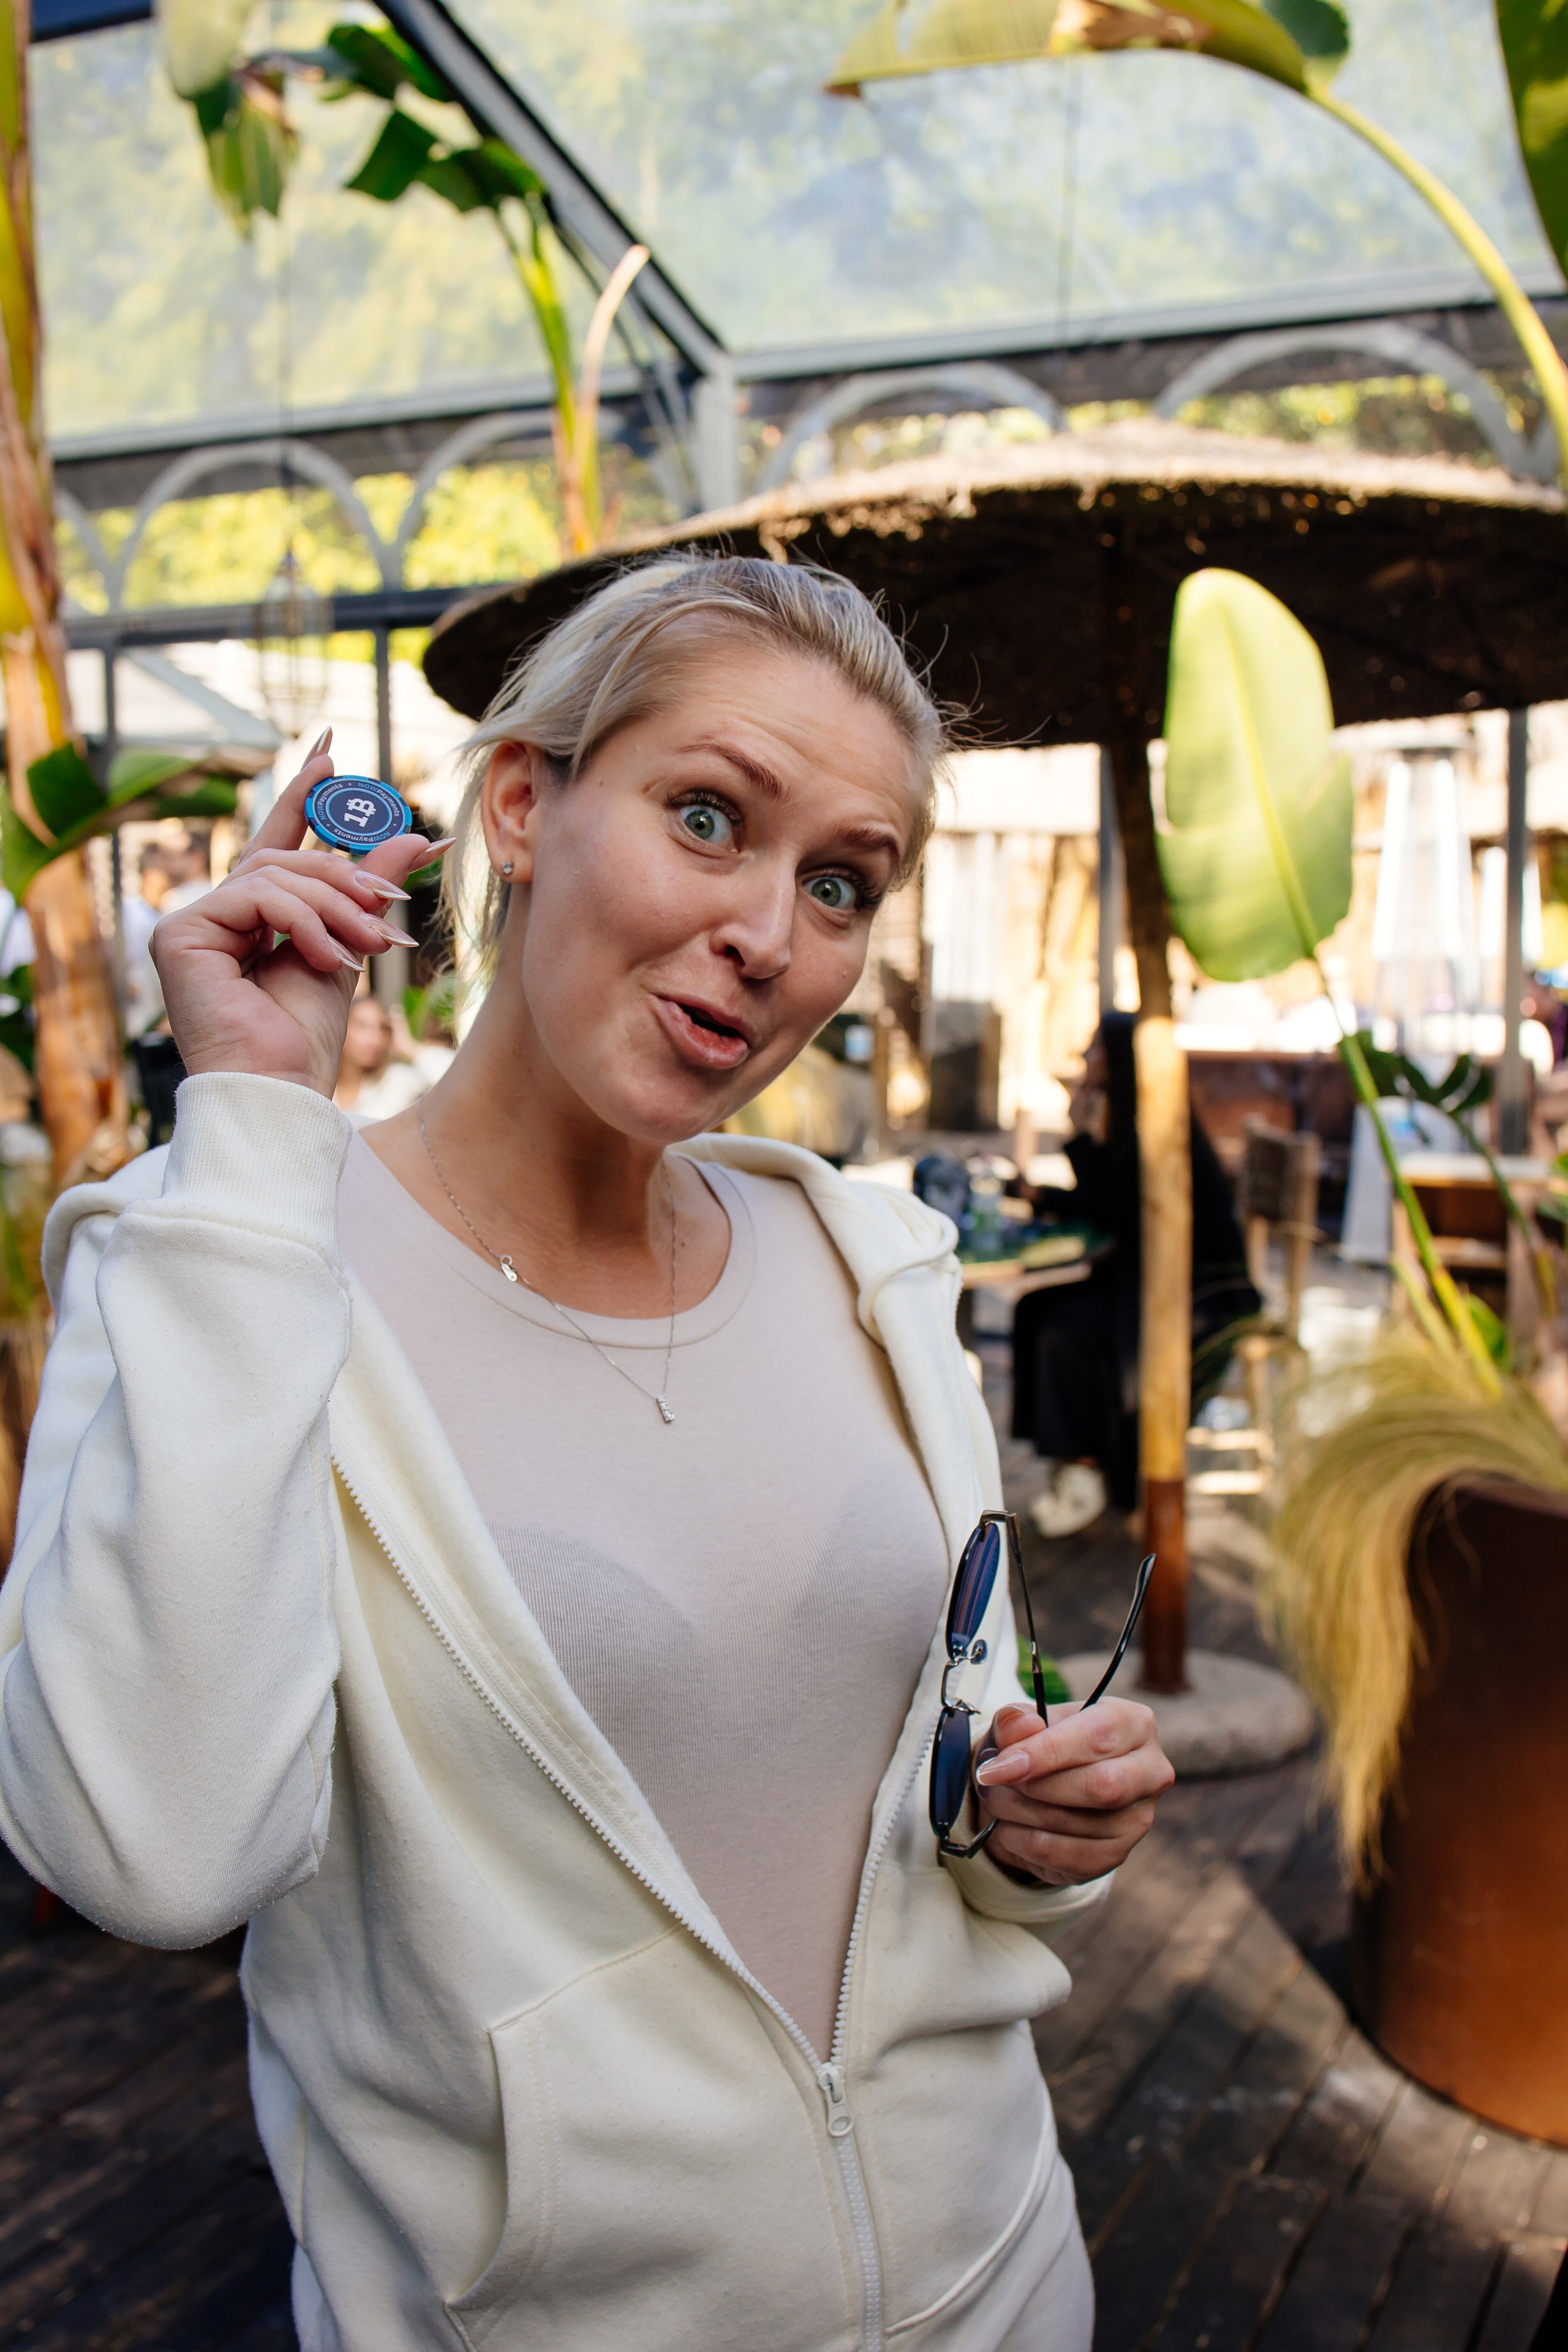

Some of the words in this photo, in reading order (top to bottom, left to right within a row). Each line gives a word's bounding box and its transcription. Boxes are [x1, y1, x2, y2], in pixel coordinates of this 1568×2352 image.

[317, 783, 344, 820] NOWPayments
[358, 782, 400, 817] NOWPayments
[333, 828, 391, 842] NOWPayments
